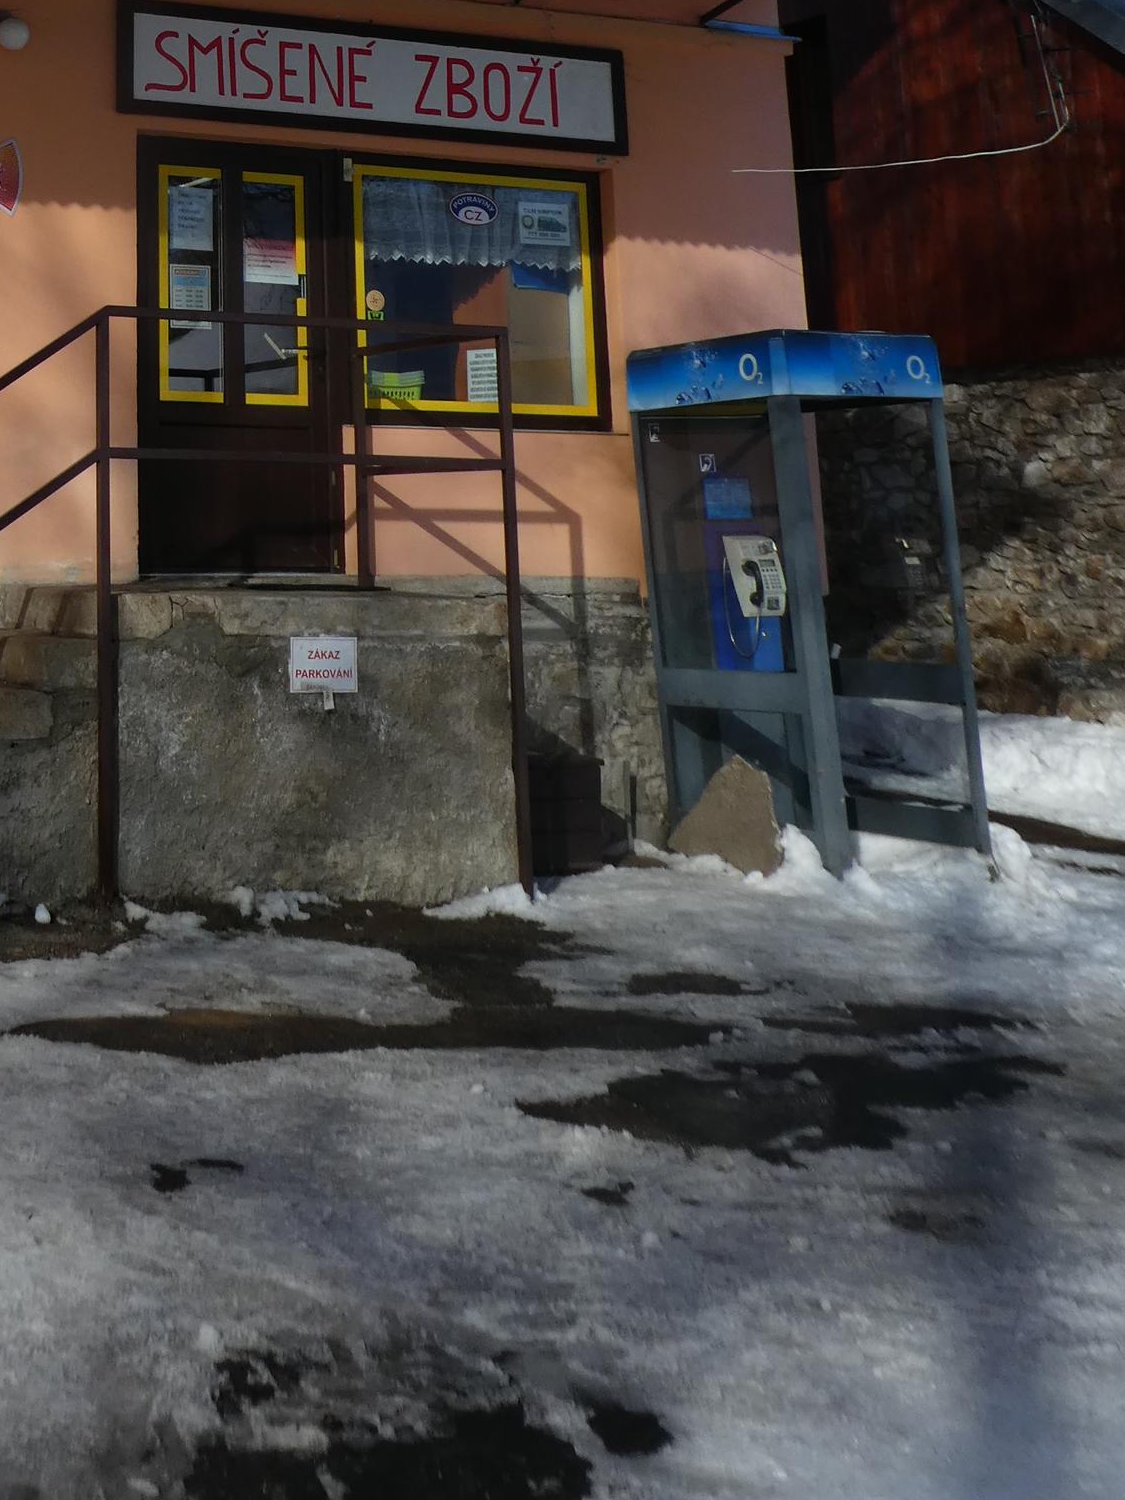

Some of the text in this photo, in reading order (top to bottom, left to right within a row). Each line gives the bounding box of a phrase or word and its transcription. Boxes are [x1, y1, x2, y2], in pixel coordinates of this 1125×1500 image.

[144, 27, 563, 128] SMÍŠENÉ ZBOŽÍ
[452, 195, 496, 213] POTRAVINY
[464, 209, 483, 222] CZ
[308, 648, 341, 660] ZÁKAZ
[295, 667, 353, 679] PARKOVÁNÍ
